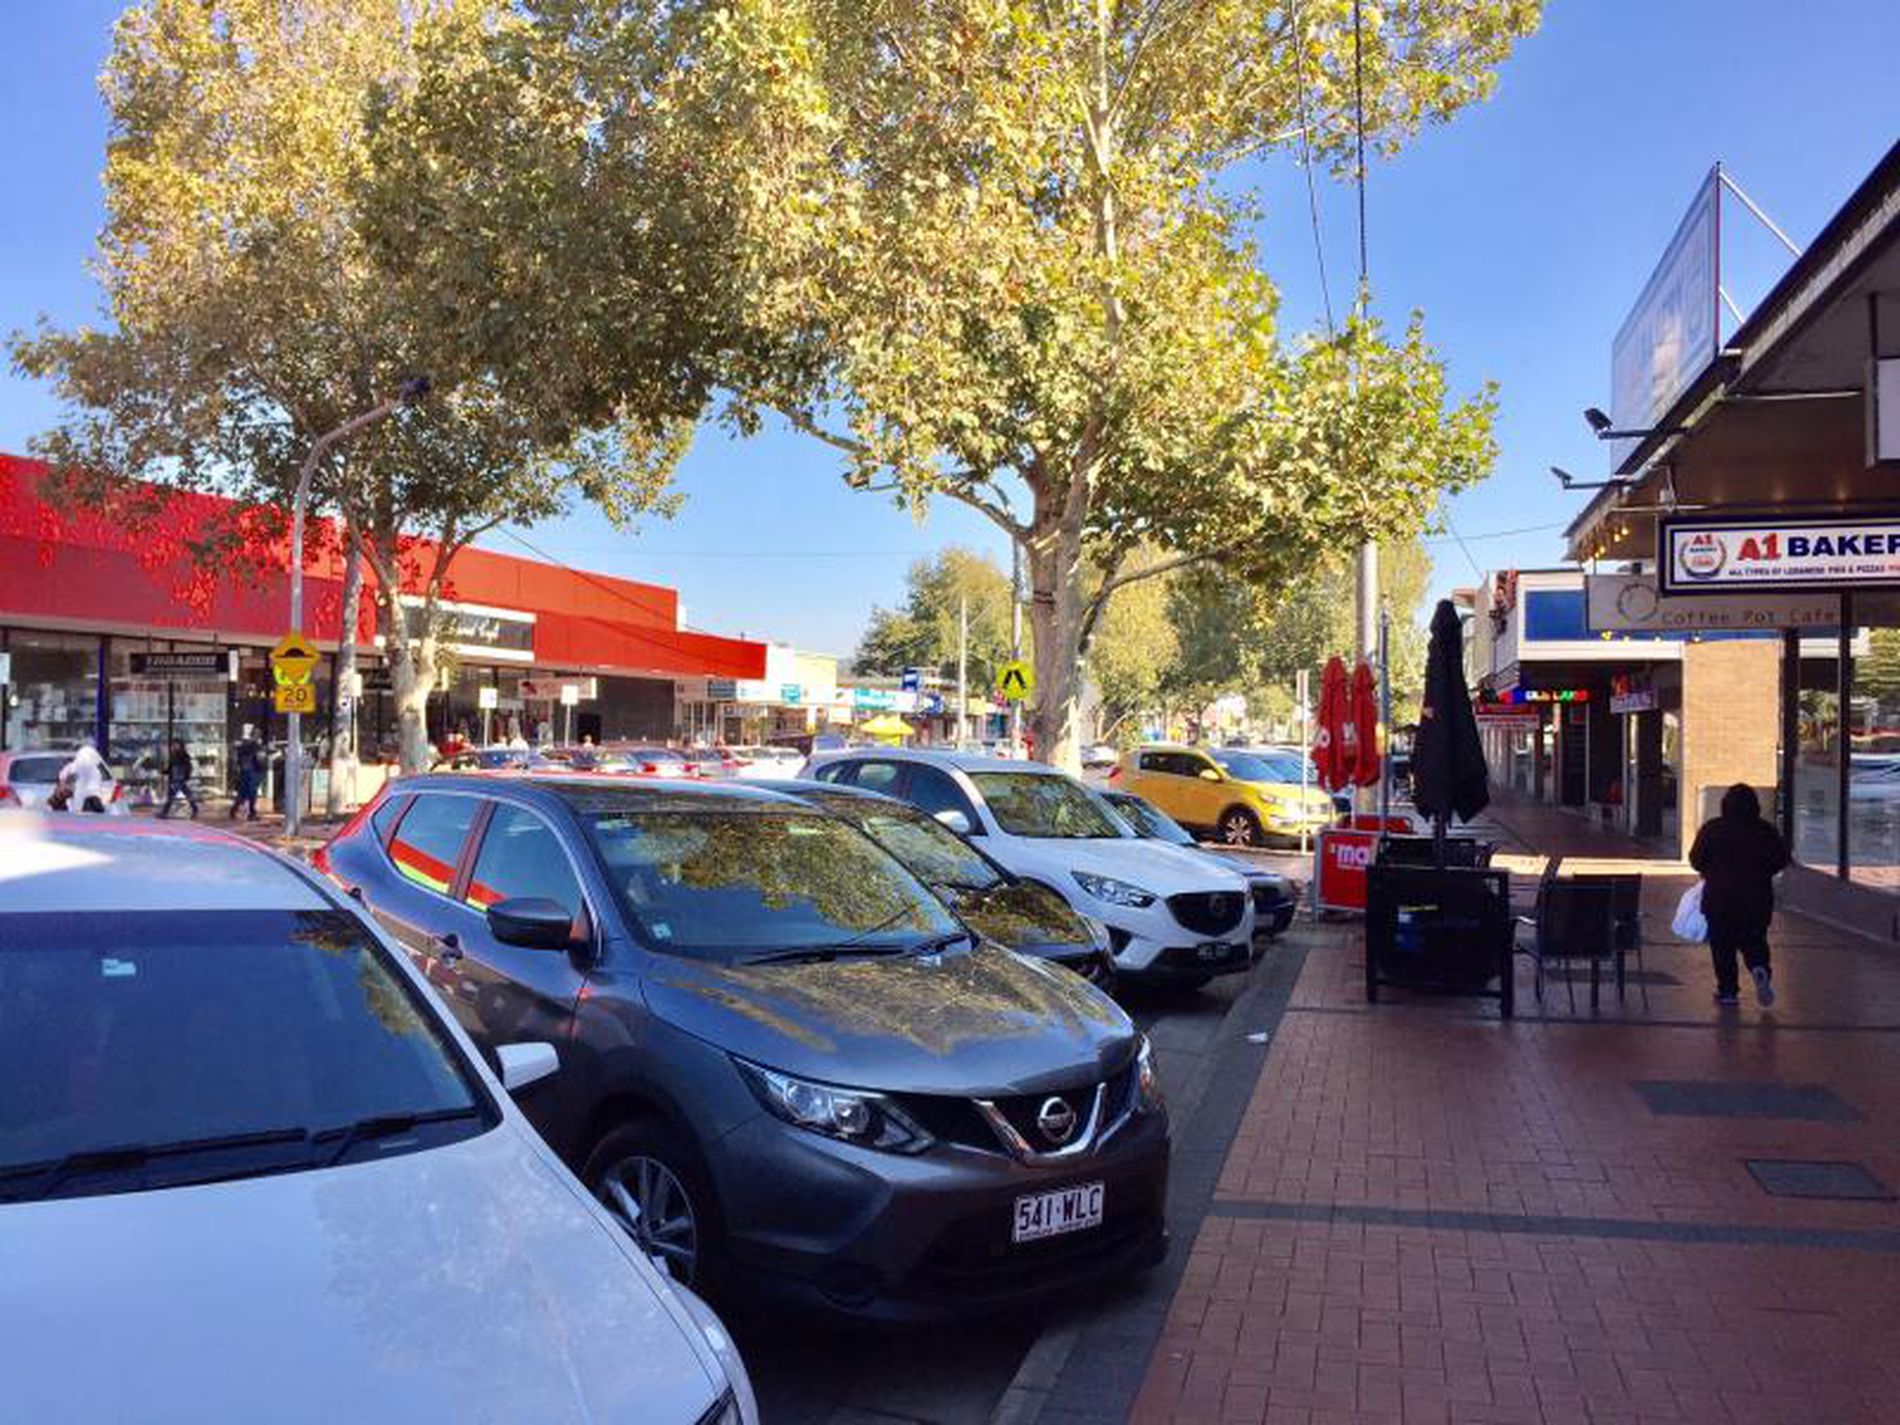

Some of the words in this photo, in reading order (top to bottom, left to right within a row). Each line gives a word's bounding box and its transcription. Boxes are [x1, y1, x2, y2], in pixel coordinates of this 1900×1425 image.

[1737, 532, 1782, 561] A1
[1662, 608, 1730, 625] Coffee
[1789, 608, 1835, 624] Cafe
[285, 687, 308, 702] 20
